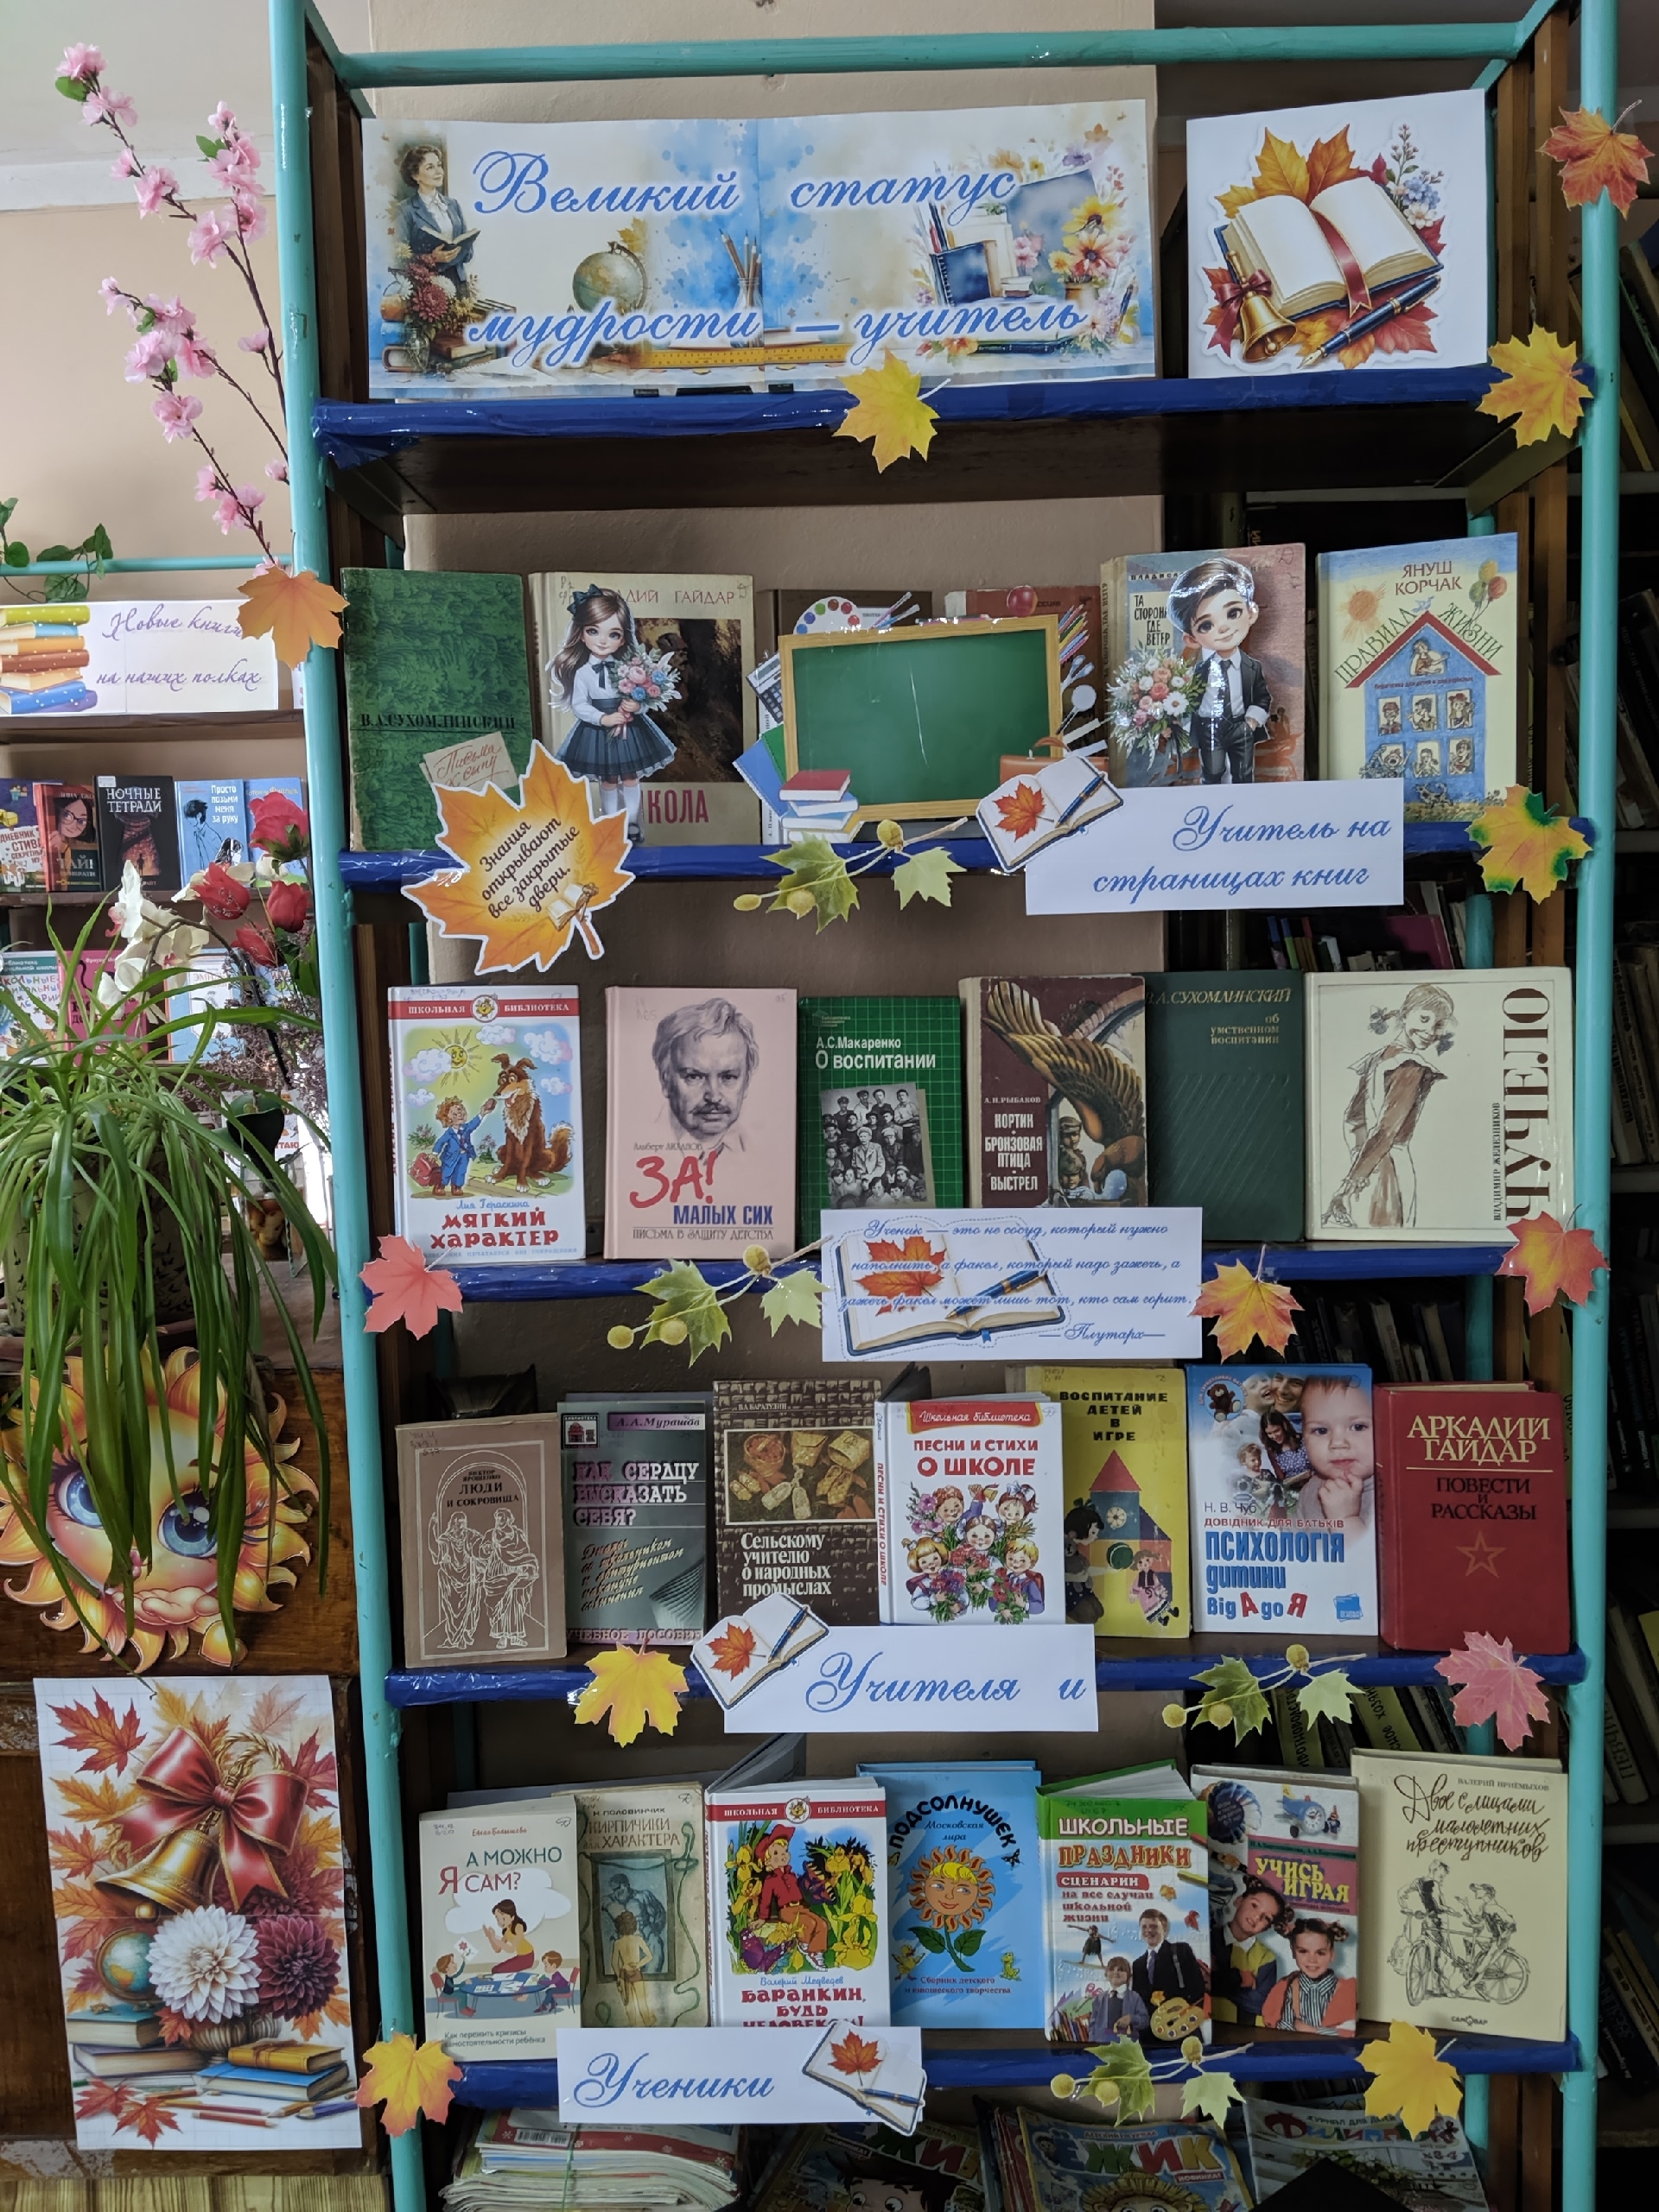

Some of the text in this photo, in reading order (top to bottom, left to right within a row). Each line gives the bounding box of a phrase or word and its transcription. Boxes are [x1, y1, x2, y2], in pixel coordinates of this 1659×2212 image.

[474, 150, 1016, 226] Великий статус
[467, 303, 1087, 367] мудрости учитель
[1402, 561, 1452, 578] ЯНУШ
[1395, 576, 1462, 595] КОРЧАК
[674, 590, 734, 604] ГАЙДАР
[1134, 595, 1144, 607] ТА
[102, 603, 243, 641] Новые книги
[1147, 621, 1161, 632] ГДЕ
[1438, 602, 1503, 660] ЖИЗНИ
[1147, 632, 1171, 646] ВЕТЕР
[1334, 607, 1417, 683] ПРАВИЛА
[96, 658, 263, 692] на наших полках
[106, 788, 161, 800] НОЧНЫЕ
[211, 785, 237, 793] Просто
[107, 800, 162, 813] ТЕТРАДИ
[643, 789, 709, 824] КОЛА
[0, 830, 35, 843] ДНЕВНИК
[1173, 804, 1391, 852] Учитель на
[480, 821, 531, 872] Знания
[481, 817, 561, 901] открывают
[488, 826, 580, 918] все закрытые
[529, 868, 571, 912] двери.
[1093, 865, 1370, 905] страницах книг
[408, 1003, 569, 1014] ШКОЛЬНАЯ БИБЛИОТЕКА
[1265, 1013, 1280, 1025] об
[1211, 1026, 1280, 1037] умственном
[1211, 1036, 1280, 1046] воспитании
[816, 1052, 936, 1070] О воспитании
[1502, 988, 1551, 1220] ЧУЧЕЛО
[995, 1114, 1033, 1130] КОРТИК
[985, 1136, 1043, 1153] БРОНЗОВАЯ
[997, 1153, 1031, 1170] ПТИЦА
[1492, 1102, 1502, 1221] ВЛАДИМИР ЖЕЛЕЗНИКОВ
[630, 1152, 718, 1209] ЗА!
[990, 1175, 1038, 1192] ВЫСТРЕЛ
[456, 1199, 477, 1210] Лия
[442, 1206, 546, 1230] МЯГКИЙ
[673, 1205, 772, 1225] МАЛЫХ СИХ
[864, 1220, 1168, 1240] Ученик это не который нужно
[430, 1230, 559, 1249] ХАРАКТЕР
[851, 1261, 938, 1272] наполнить,
[940, 1262, 950, 1270] а
[954, 1259, 1003, 1274] факел,
[1007, 1258, 1072, 1274] который
[1075, 1261, 1110, 1275] надо
[893, 1294, 937, 1309] факел
[939, 1297, 992, 1306] может
[994, 1297, 1032, 1306] лишь
[1059, 1390, 1167, 1403] ВОСПИТАНИЕ
[918, 1409, 1032, 1423] Школьная библиотека
[1086, 1404, 1142, 1417] ДЕТЕЙ
[1110, 1418, 1120, 1428] В
[1406, 1415, 1550, 1440] АРКАДИЙ
[914, 1440, 1039, 1452] ПЕСНИ И СТИХИ
[1092, 1431, 1136, 1443] ИГРЕ
[1424, 1438, 1537, 1465] ГАЙДАР
[574, 1461, 700, 1484] КАК СЕРДЦУ
[918, 1457, 1036, 1477] О ШКОЛЕ
[459, 1483, 503, 1495] ЛЮДИ
[574, 1484, 688, 1503] ВЫСКАЗАТЬ
[1436, 1476, 1530, 1496] ПОВЕСТИ
[456, 1495, 519, 1508] СОКРОВИЩА
[1236, 1501, 1257, 1516] Чуб
[574, 1507, 637, 1527] СЕБЯ?
[1432, 1503, 1536, 1522] РАССКАЗЫ
[1204, 1518, 1345, 1529] ДОВІДНИК ДЛЯ БАТЬКІВ
[741, 1532, 826, 1551] Сельскому
[1205, 1530, 1345, 1563] ПСИХОЛОГІЯ
[743, 1550, 810, 1567] учителю
[741, 1566, 831, 1582] о народных
[1205, 1565, 1287, 1594] дитини
[743, 1581, 832, 1599] промыслах
[1240, 1592, 1308, 1618] А Я
[805, 1651, 1087, 1713] Учителя и
[1458, 1777, 1495, 1788] ВАЛЕРИЙ
[1394, 1773, 1545, 1823] Двое лицами
[724, 1805, 880, 1816] ШКОЛЬНАЯ БИБЛИОТЕКА
[588, 1818, 671, 1834] КИРПИЧИКИ
[888, 1795, 1016, 1848] ПОДСОЛНУШЕК
[925, 1821, 984, 1830] Московская
[1058, 1817, 1188, 1837] ШКОЛЬНЫЕ
[1427, 1817, 1551, 1837] малолетних
[601, 1833, 680, 1849] ХАРАКТЕРА
[1407, 1831, 1549, 1862] преступников
[466, 1847, 563, 1867] А МОЖНО
[1058, 1844, 1192, 1870] ПРАЗДНИКИ
[1255, 1857, 1324, 1882] УЧИСЬ
[438, 1866, 522, 1895] Я САМ?
[1061, 1877, 1139, 1887] СЦЕНАРИИ
[1107, 1891, 1154, 1901] случаи
[1283, 1878, 1350, 1903] ИГРАЯ
[1062, 1902, 1132, 1911] школьной
[1063, 1914, 1109, 1923] жизни
[760, 1975, 844, 1987] Валерий Медведев
[741, 1987, 866, 2003] БАРАНКИН,
[777, 2005, 829, 2017] БУДЬ
[574, 2053, 775, 2108] Ученики
